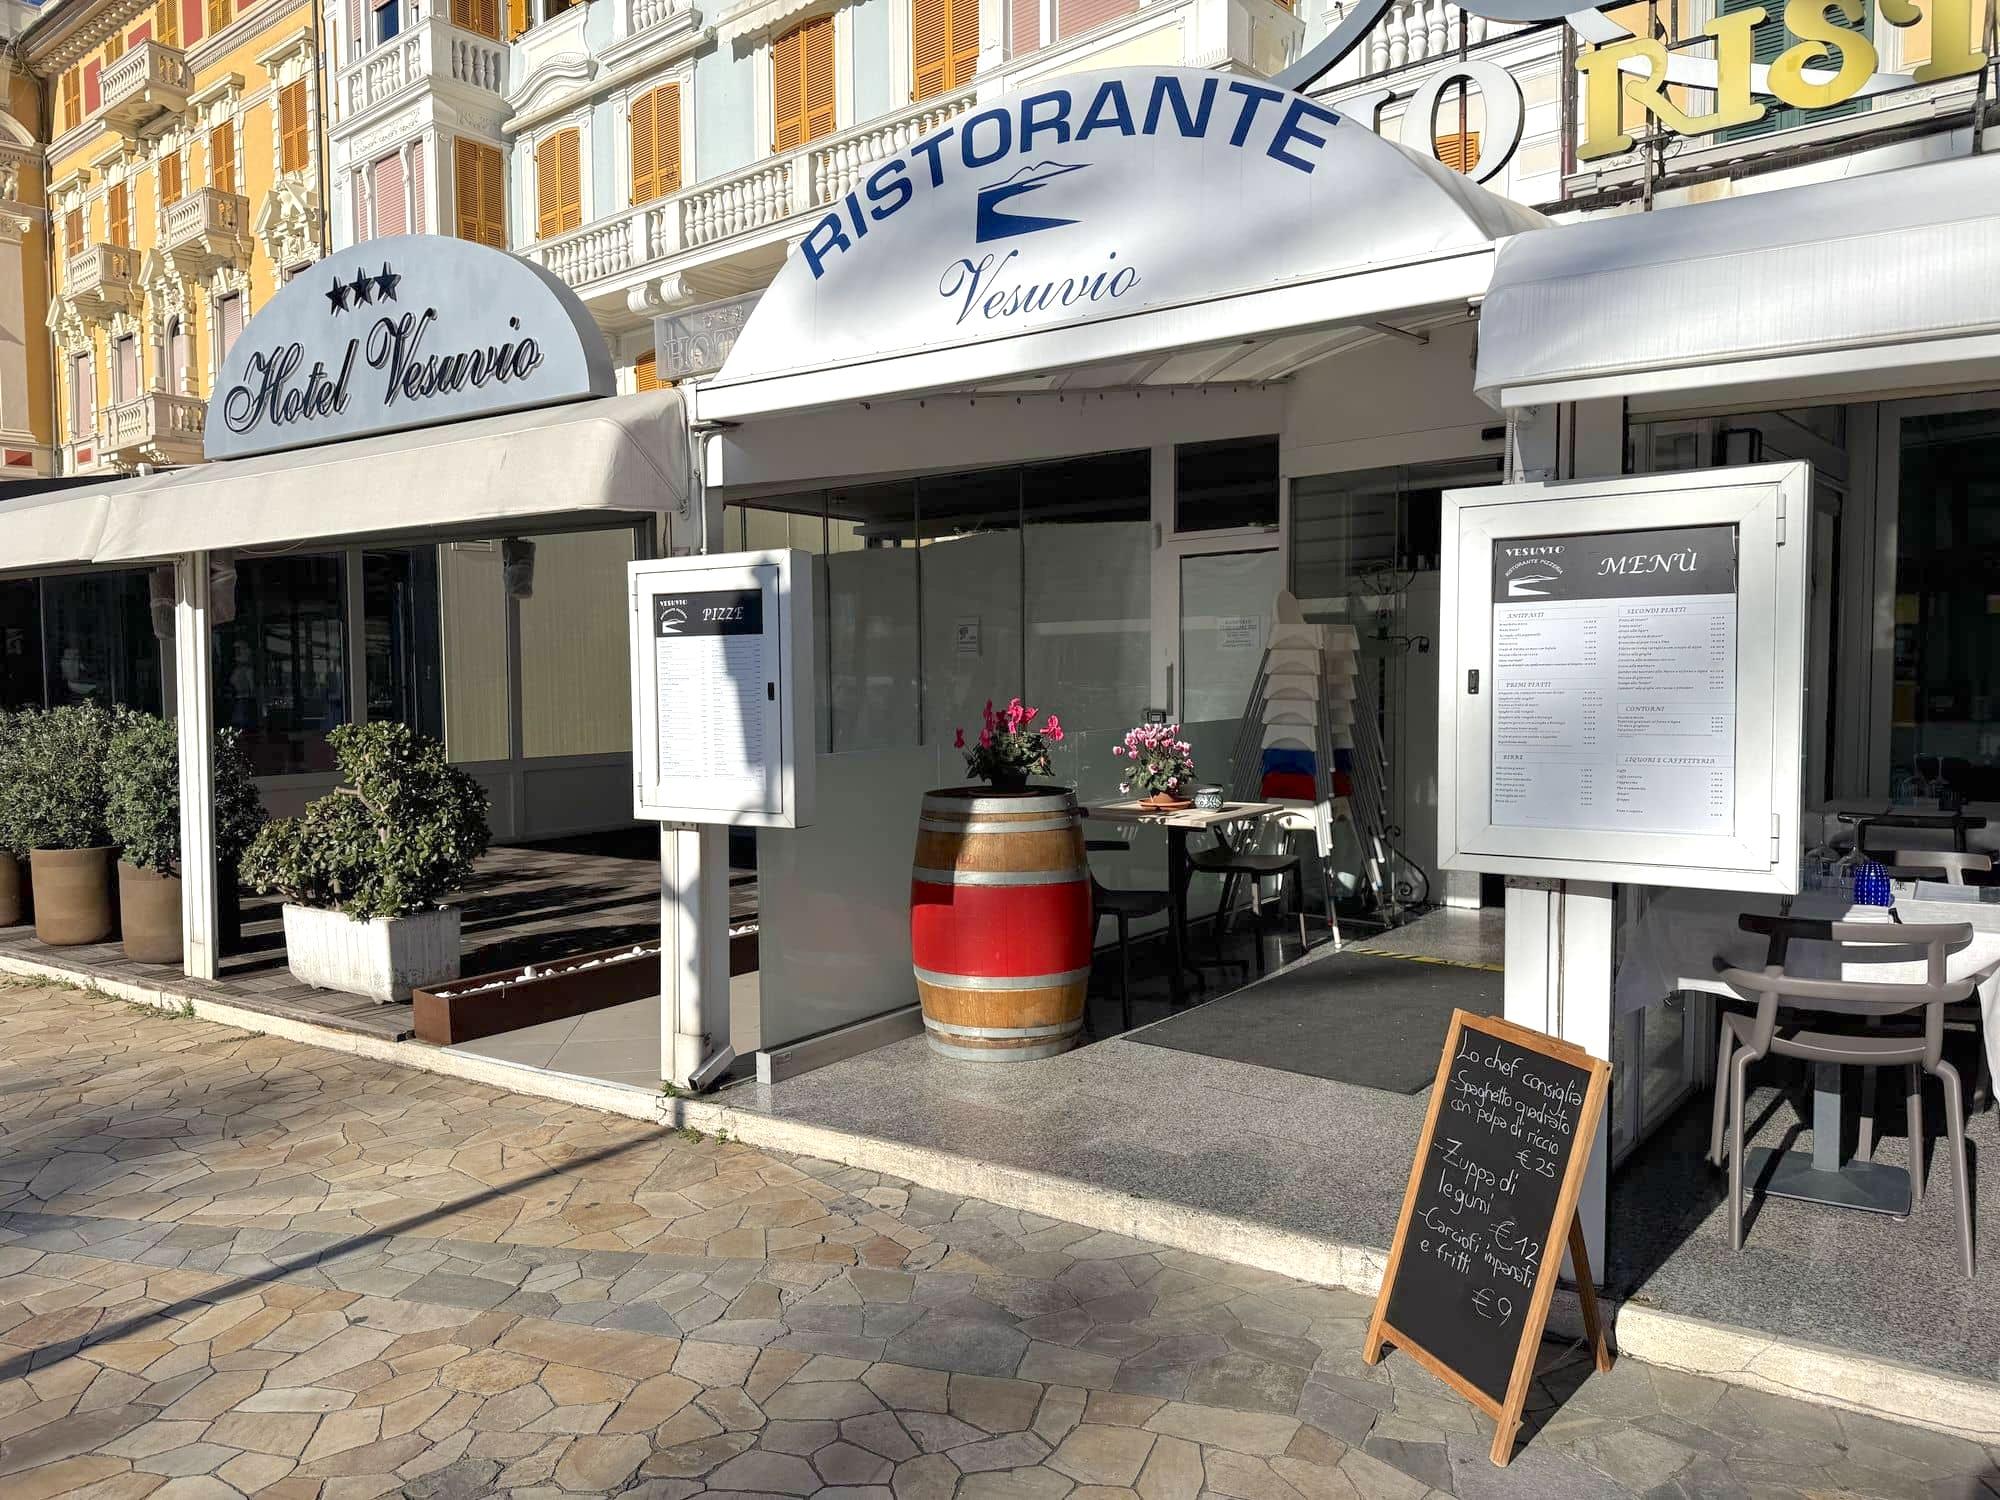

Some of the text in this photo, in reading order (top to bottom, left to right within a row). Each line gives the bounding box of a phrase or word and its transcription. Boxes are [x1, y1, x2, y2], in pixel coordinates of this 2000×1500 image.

[799, 75, 1341, 281] RISTORANTE
[939, 249, 1142, 326] Vesuvio
[223, 307, 545, 434] Hotel Vesuvio
[664, 324, 746, 374] HOT
[1505, 545, 1565, 557] VESUVIO
[1597, 547, 1698, 576] MENÙ
[702, 606, 745, 621] PIZZE
[1626, 606, 1687, 615] SECONDI PIATTI
[1456, 1030, 1582, 1116] Lo chef consiglia
[1450, 1098, 1559, 1155] con polpa di riccio
[1438, 1167, 1495, 1215] legumi
[1499, 1168, 1519, 1195] di
[1420, 1239, 1472, 1274] e fritti
[1484, 1243, 1536, 1288] impanati
